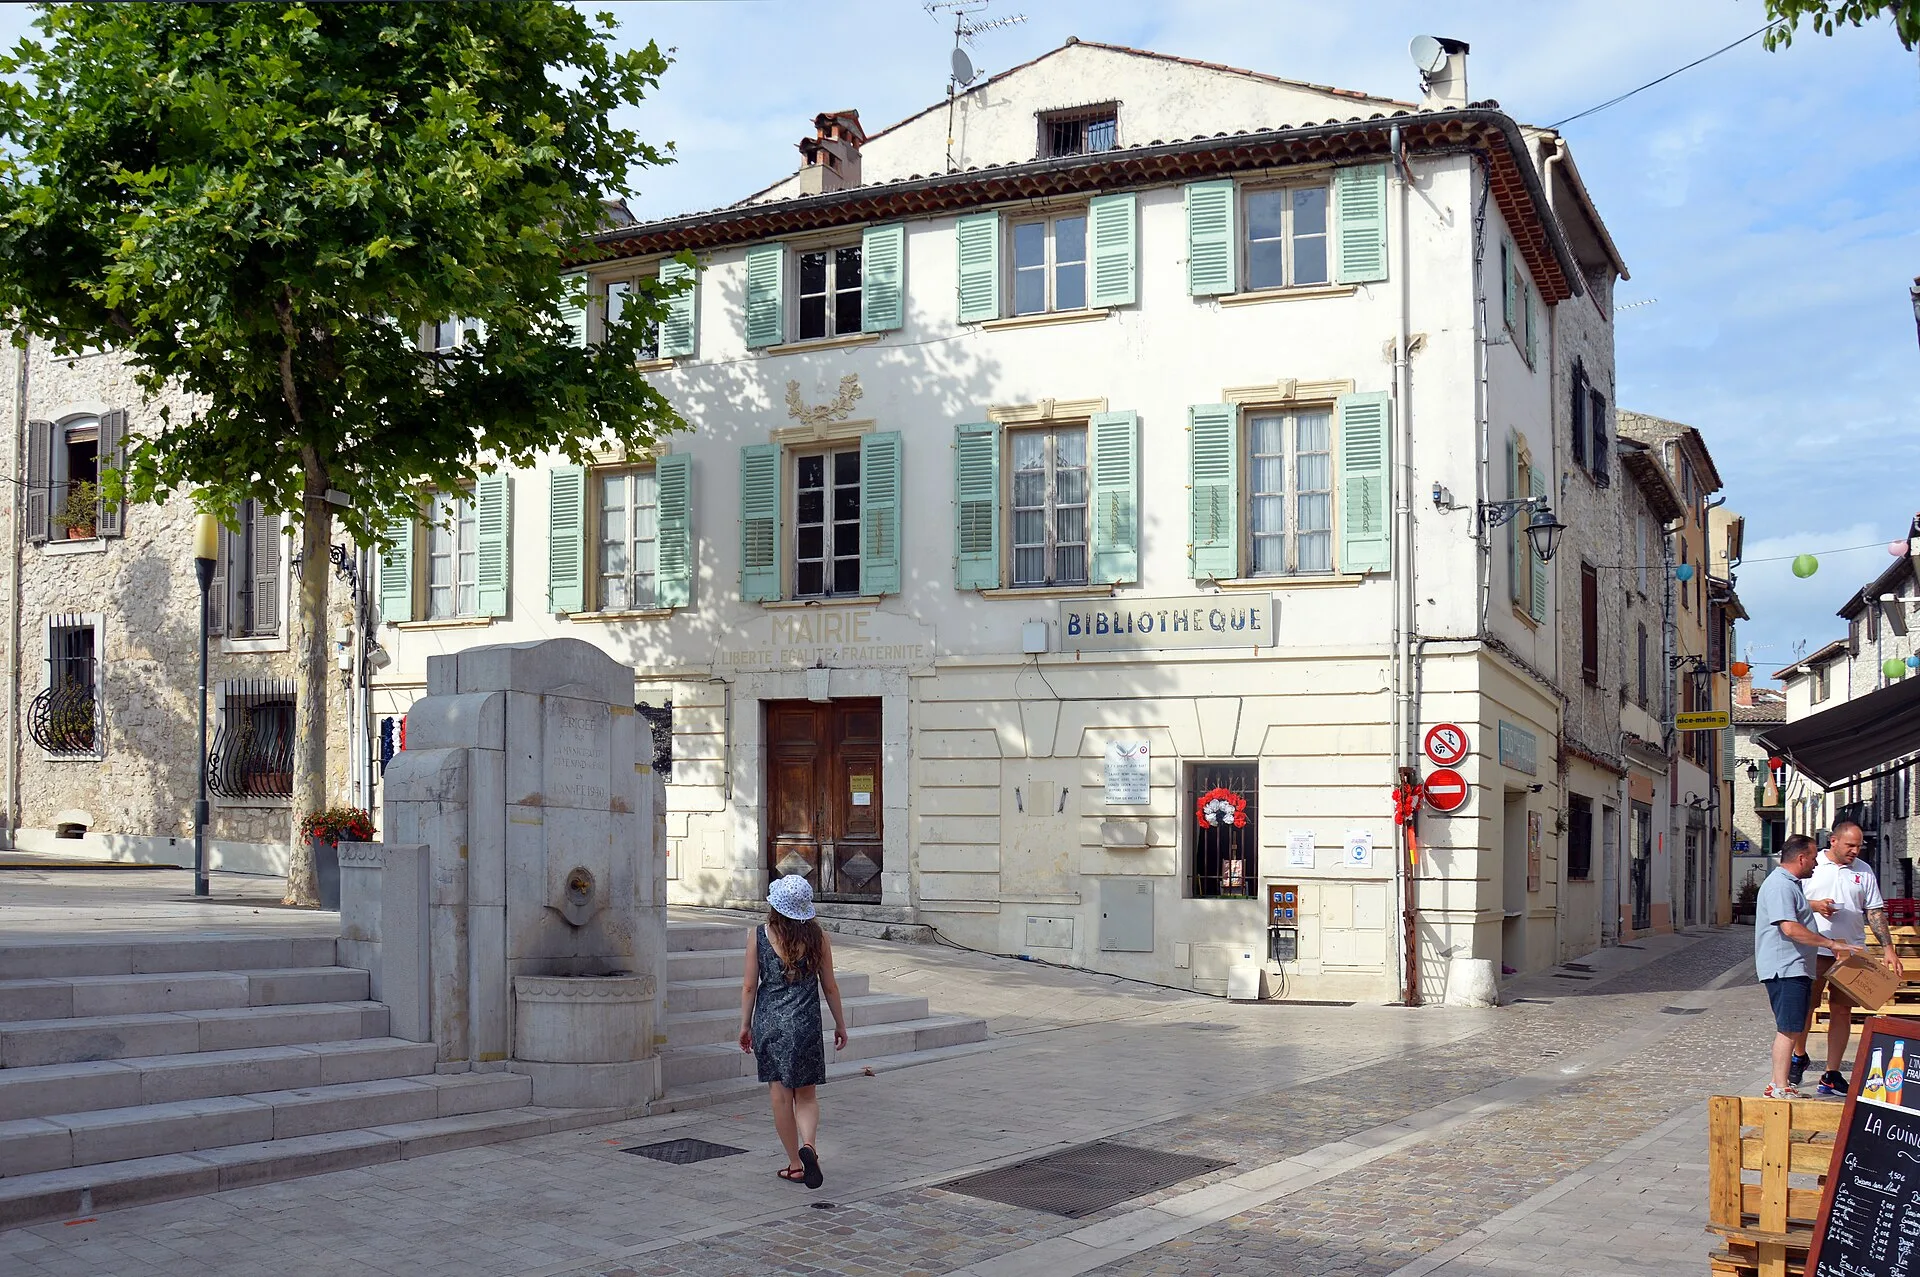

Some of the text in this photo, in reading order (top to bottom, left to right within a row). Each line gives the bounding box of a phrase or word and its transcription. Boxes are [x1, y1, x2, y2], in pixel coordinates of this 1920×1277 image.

[771, 611, 871, 645] MAIRIE
[1068, 608, 1261, 636] BIBLIOTHEQUE
[721, 650, 772, 665] LIBERTE
[841, 644, 924, 660] FRATERNITE
[1677, 716, 1717, 724] nice-matin
[1864, 1112, 1882, 1136] LA
